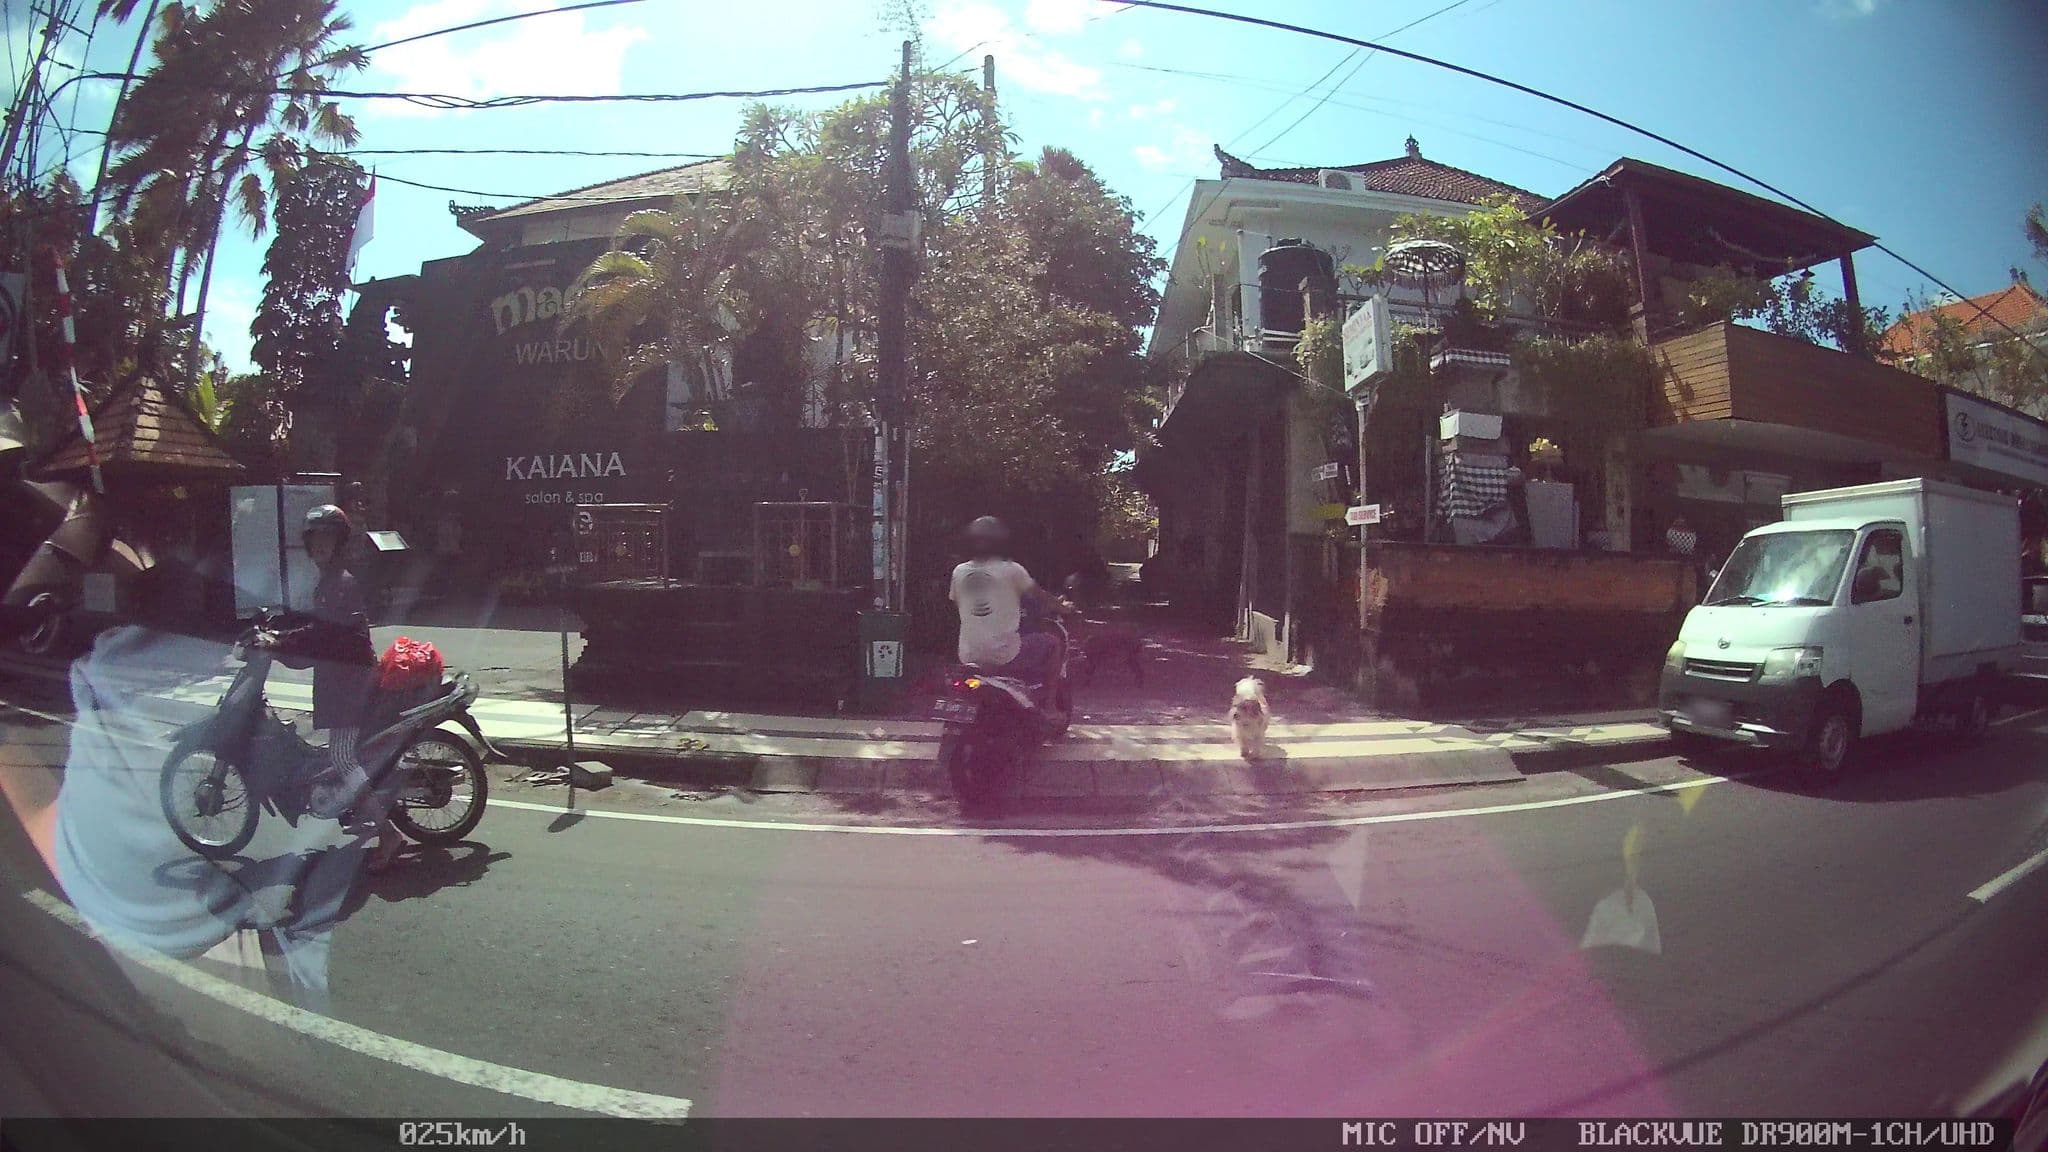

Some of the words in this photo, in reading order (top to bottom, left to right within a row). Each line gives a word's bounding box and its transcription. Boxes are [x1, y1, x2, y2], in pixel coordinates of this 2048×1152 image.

[506, 452, 626, 480] KAIANA
[525, 491, 560, 504] salon
[565, 491, 574, 503] &
[578, 491, 603, 504] spa
